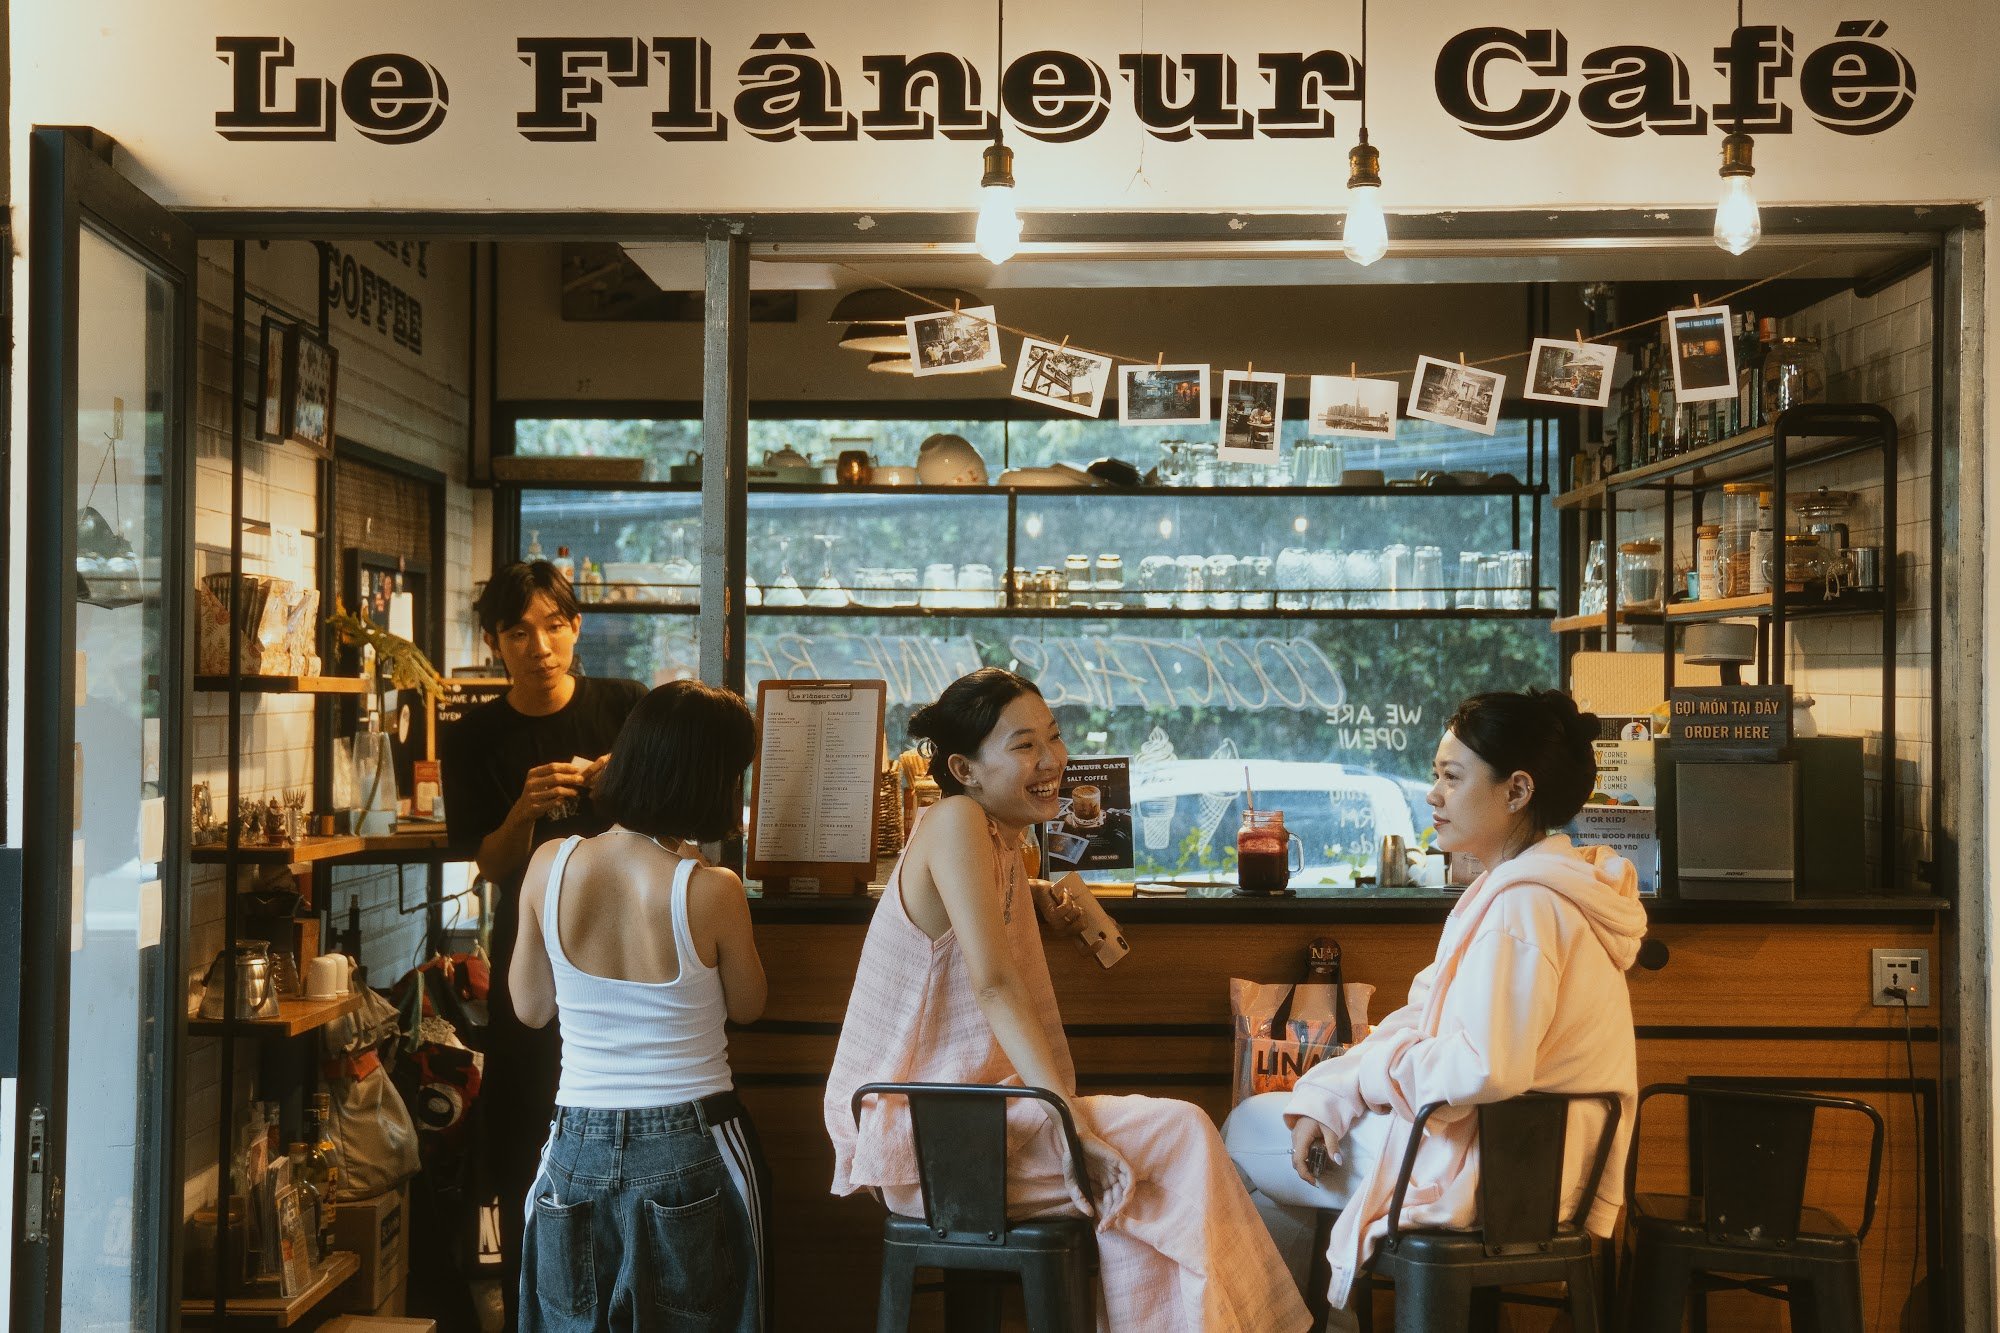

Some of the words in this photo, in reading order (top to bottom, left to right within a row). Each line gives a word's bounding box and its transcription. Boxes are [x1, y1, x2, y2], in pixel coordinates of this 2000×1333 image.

[215, 35, 450, 145] Le
[516, 31, 1363, 143] Flâneur
[1435, 19, 1917, 141] Café
[1675, 701, 1695, 717] GỌI
[1699, 698, 1728, 715] MÓN
[1731, 701, 1751, 717] TẠI
[1754, 698, 1780, 715] ĐÂY
[1684, 725, 1730, 739] ORDER
[1734, 725, 1771, 739] HERE
[1084, 774, 1109, 782] COFFEE
[1603, 782, 1628, 790] SUMMER
[1606, 815, 1626, 824] KIDS
[1601, 832, 1626, 840] WOOD
